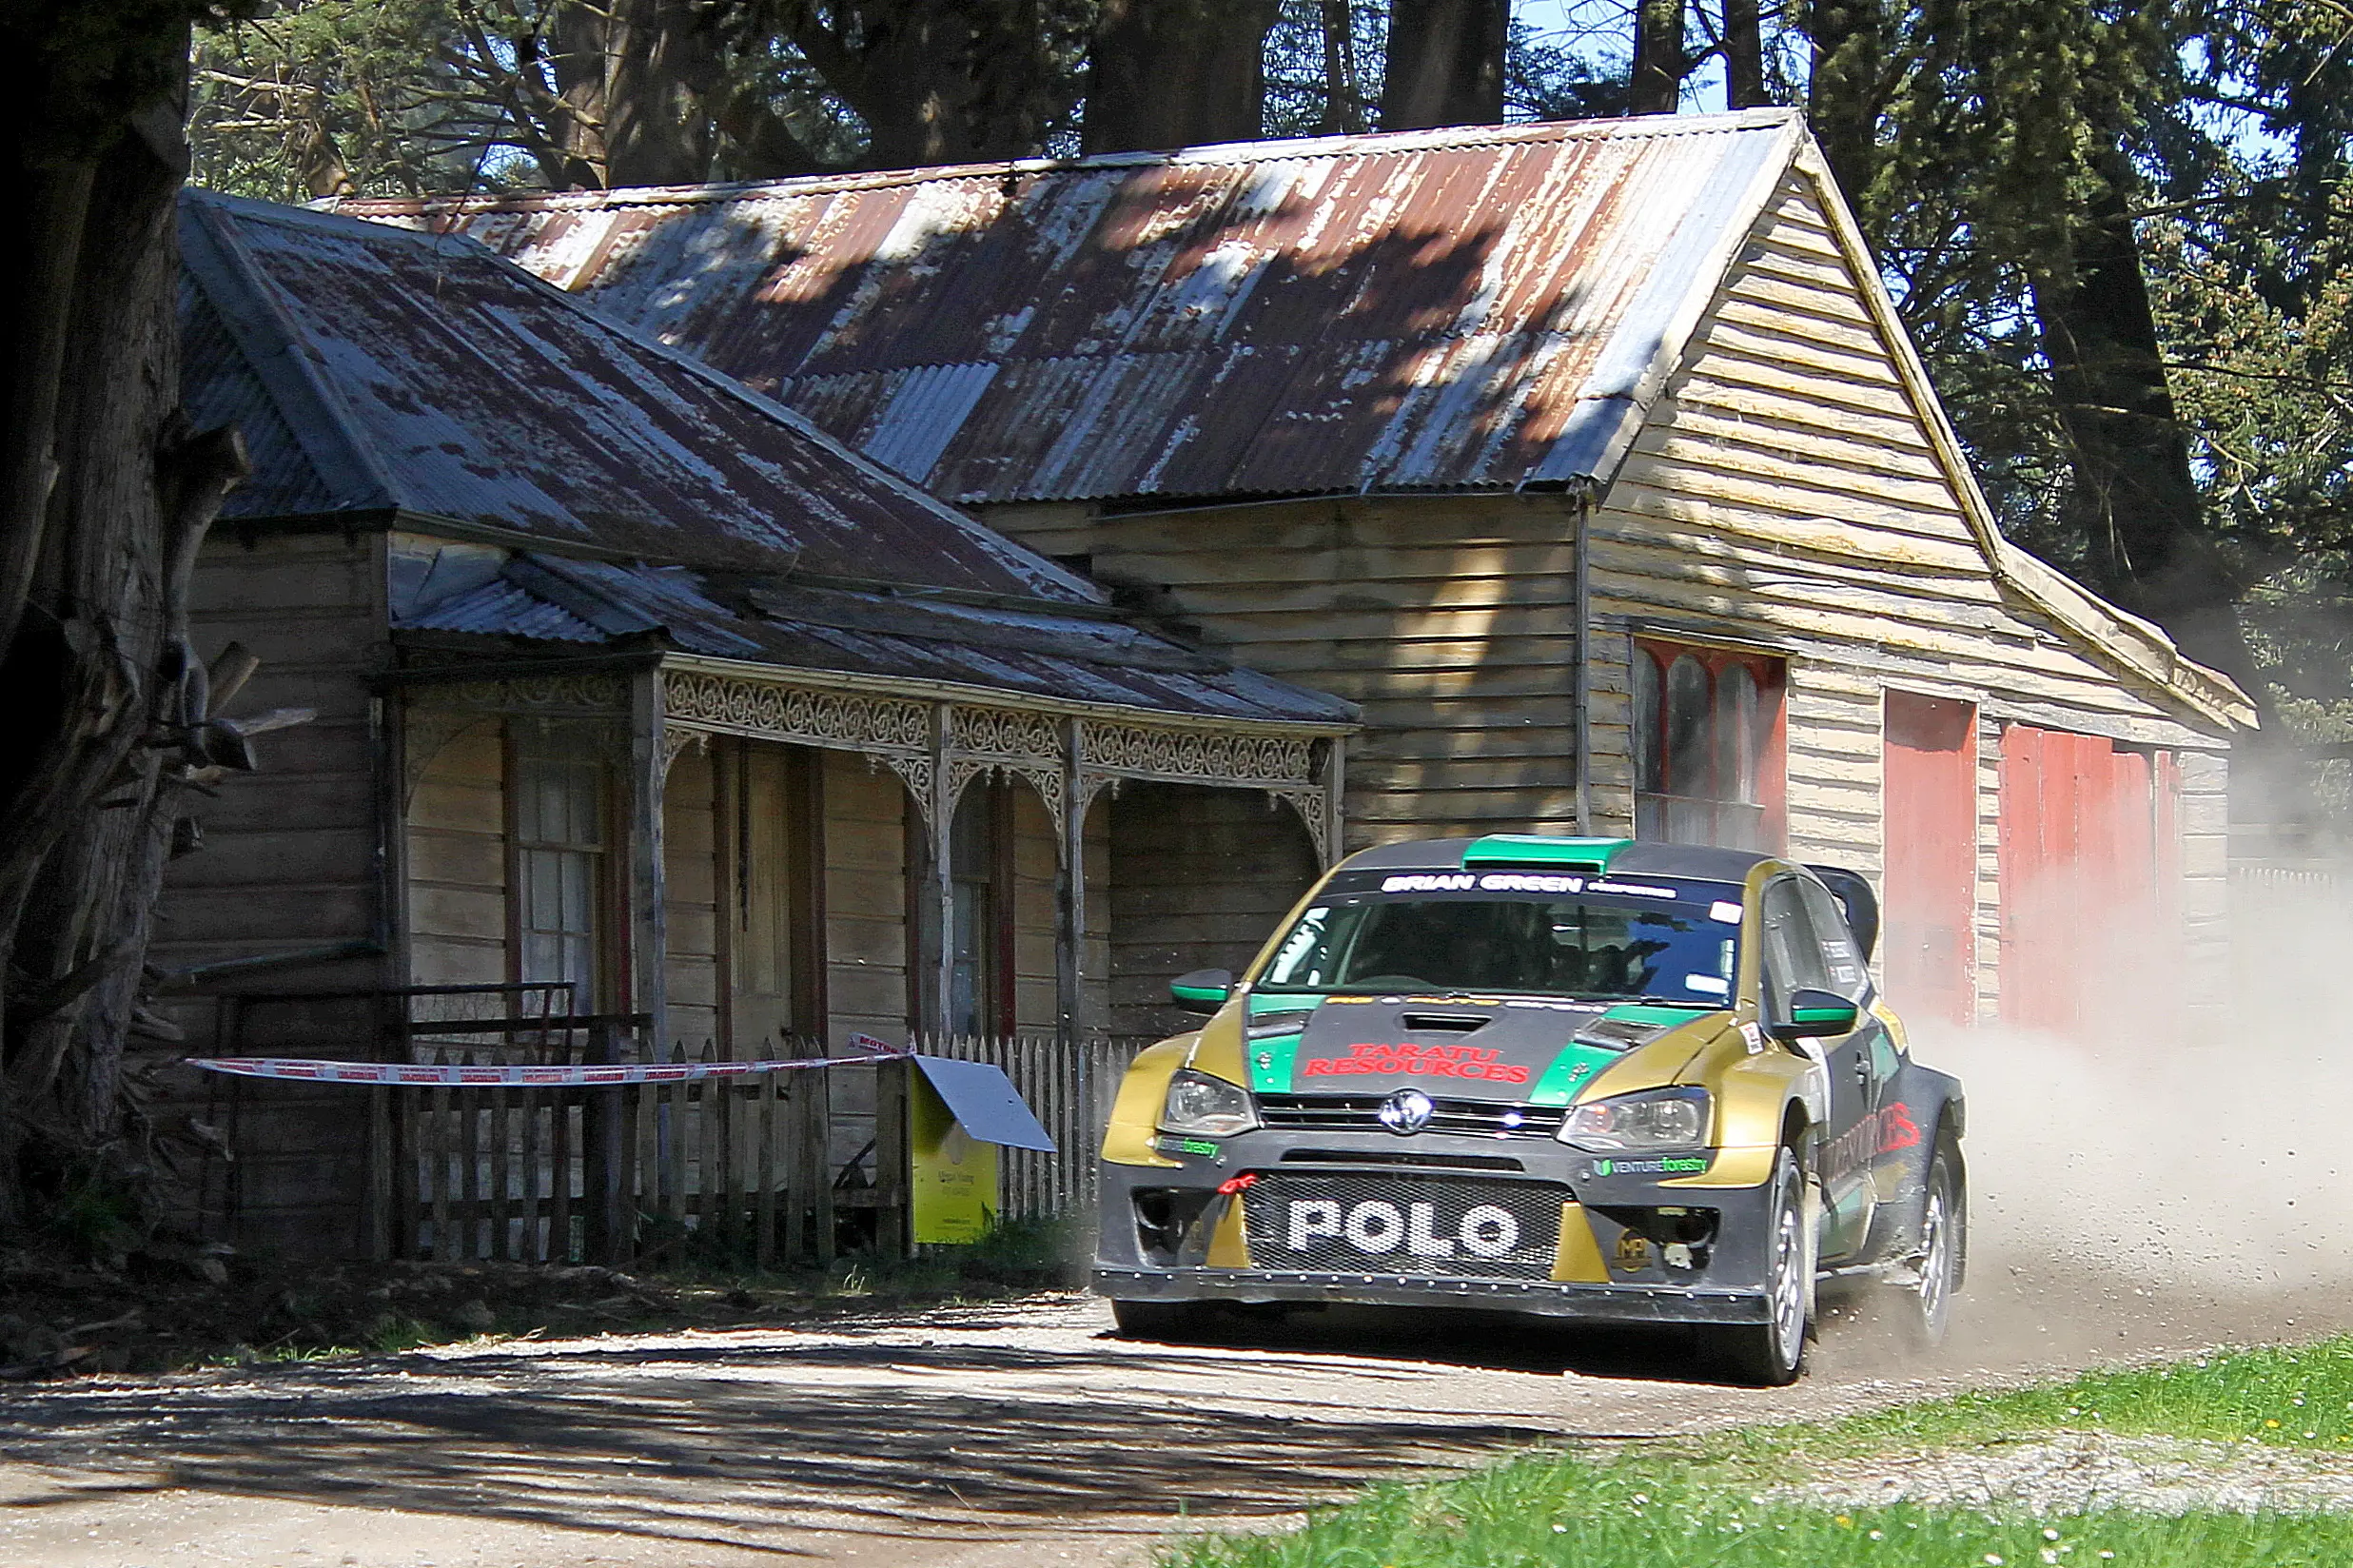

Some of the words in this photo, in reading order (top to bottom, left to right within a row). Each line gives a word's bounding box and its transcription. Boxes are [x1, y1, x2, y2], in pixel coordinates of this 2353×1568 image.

[1381, 874, 1475, 892] BRIAN
[1480, 875, 1583, 893] GREEN
[1348, 1043, 1500, 1062] TARATU
[1303, 1057, 1530, 1085] RESOURCES
[1287, 1199, 1520, 1258] POLO
